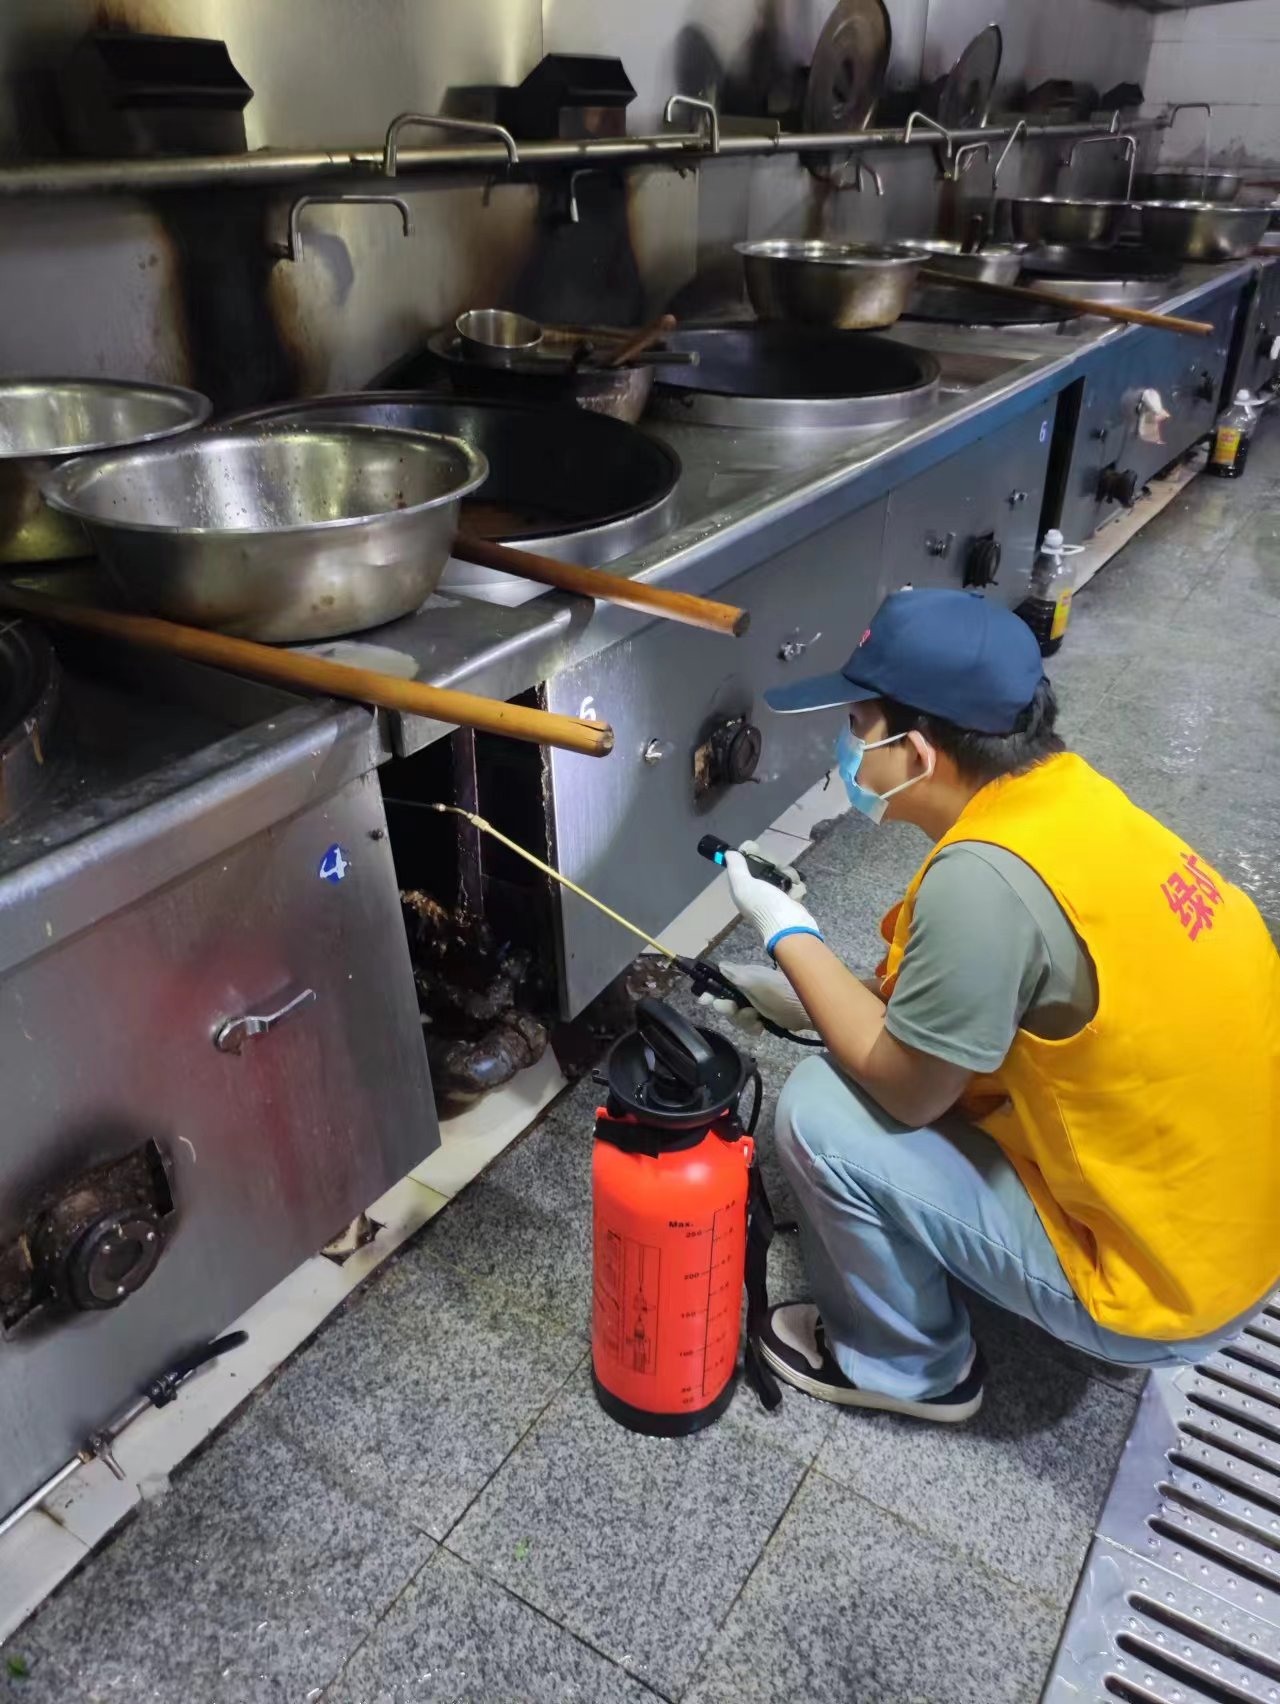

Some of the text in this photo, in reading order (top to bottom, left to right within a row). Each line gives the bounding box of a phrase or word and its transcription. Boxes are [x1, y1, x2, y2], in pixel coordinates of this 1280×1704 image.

[1039, 420, 1048, 443] 6
[319, 846, 352, 879] 4
[668, 1220, 694, 1229] Max.
[683, 1271, 700, 1281] 200
